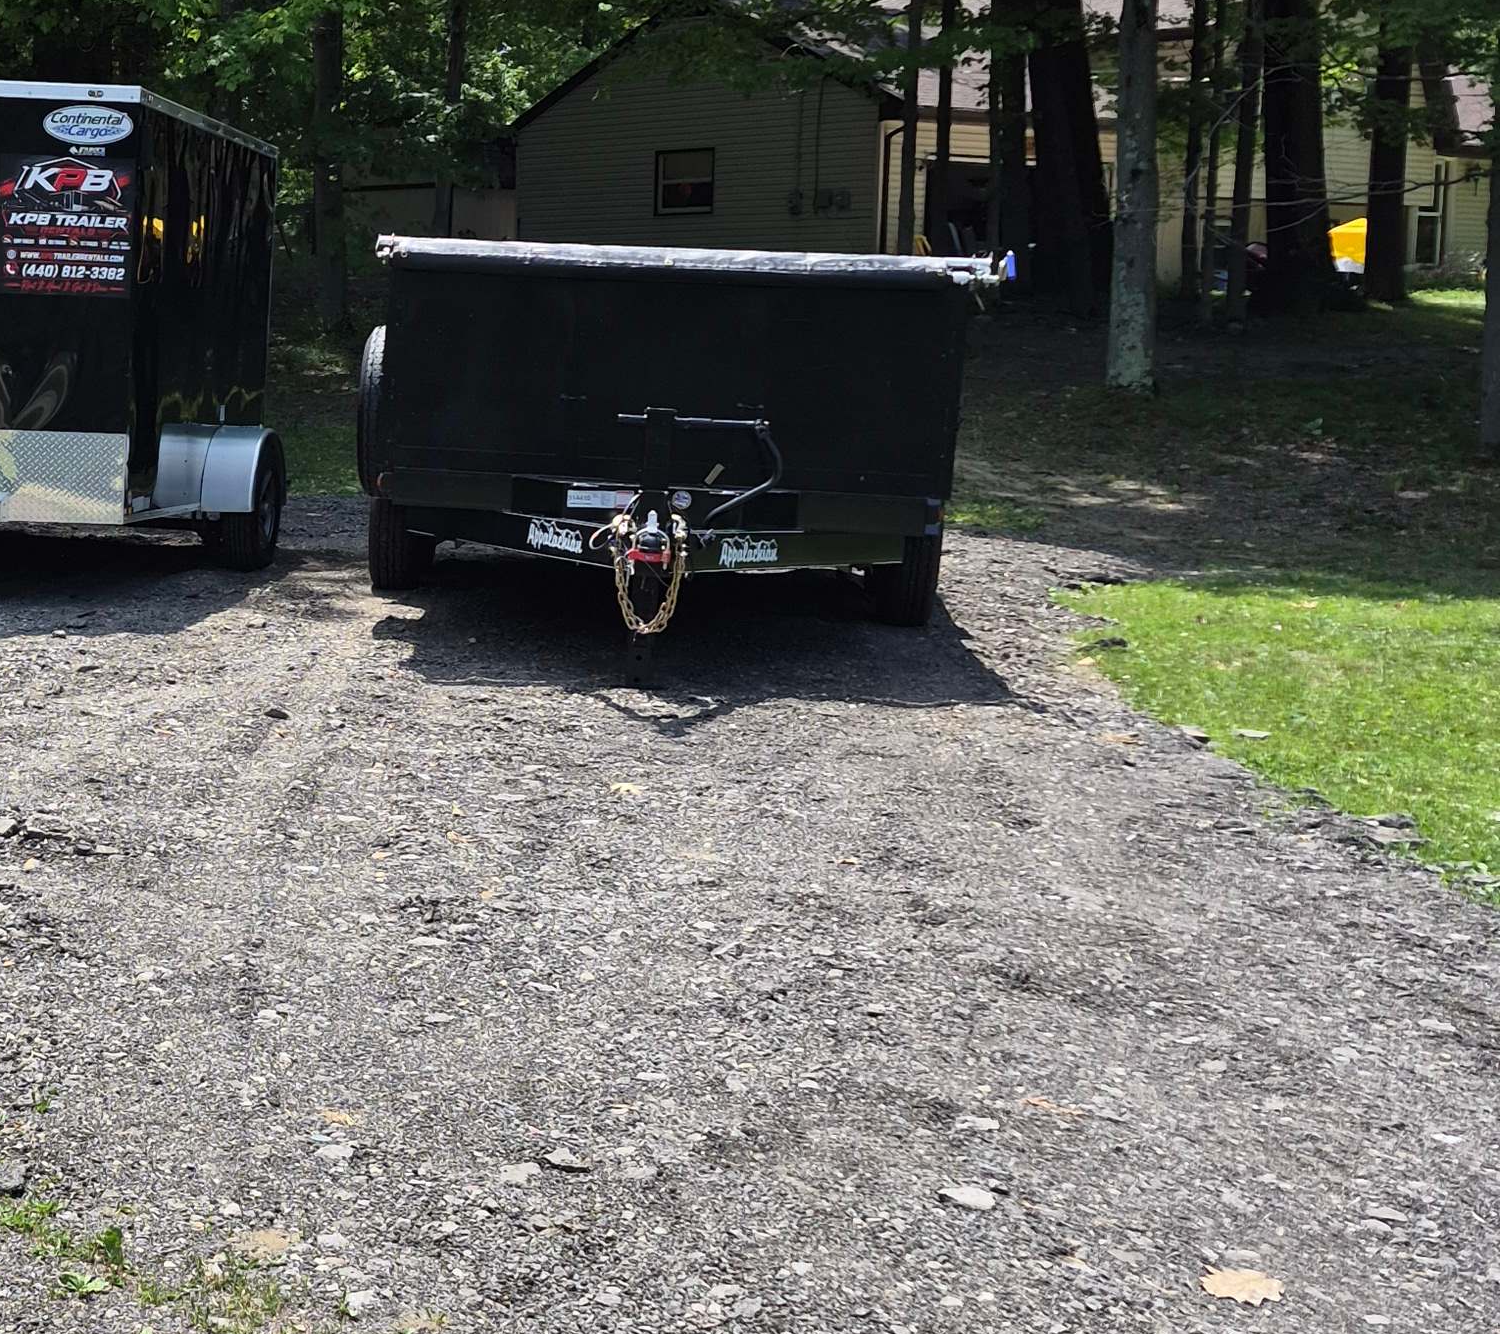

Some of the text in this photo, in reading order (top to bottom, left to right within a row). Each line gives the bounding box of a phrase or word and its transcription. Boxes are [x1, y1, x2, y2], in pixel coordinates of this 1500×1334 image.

[51, 112, 125, 125] Continental
[68, 125, 108, 139] Cargo
[23, 166, 114, 192] KPB
[9, 212, 128, 229] KPB TRAILER
[21, 263, 125, 280] (440) 812-3382
[527, 523, 583, 554] Appalachian
[718, 541, 779, 567] Appalachian
